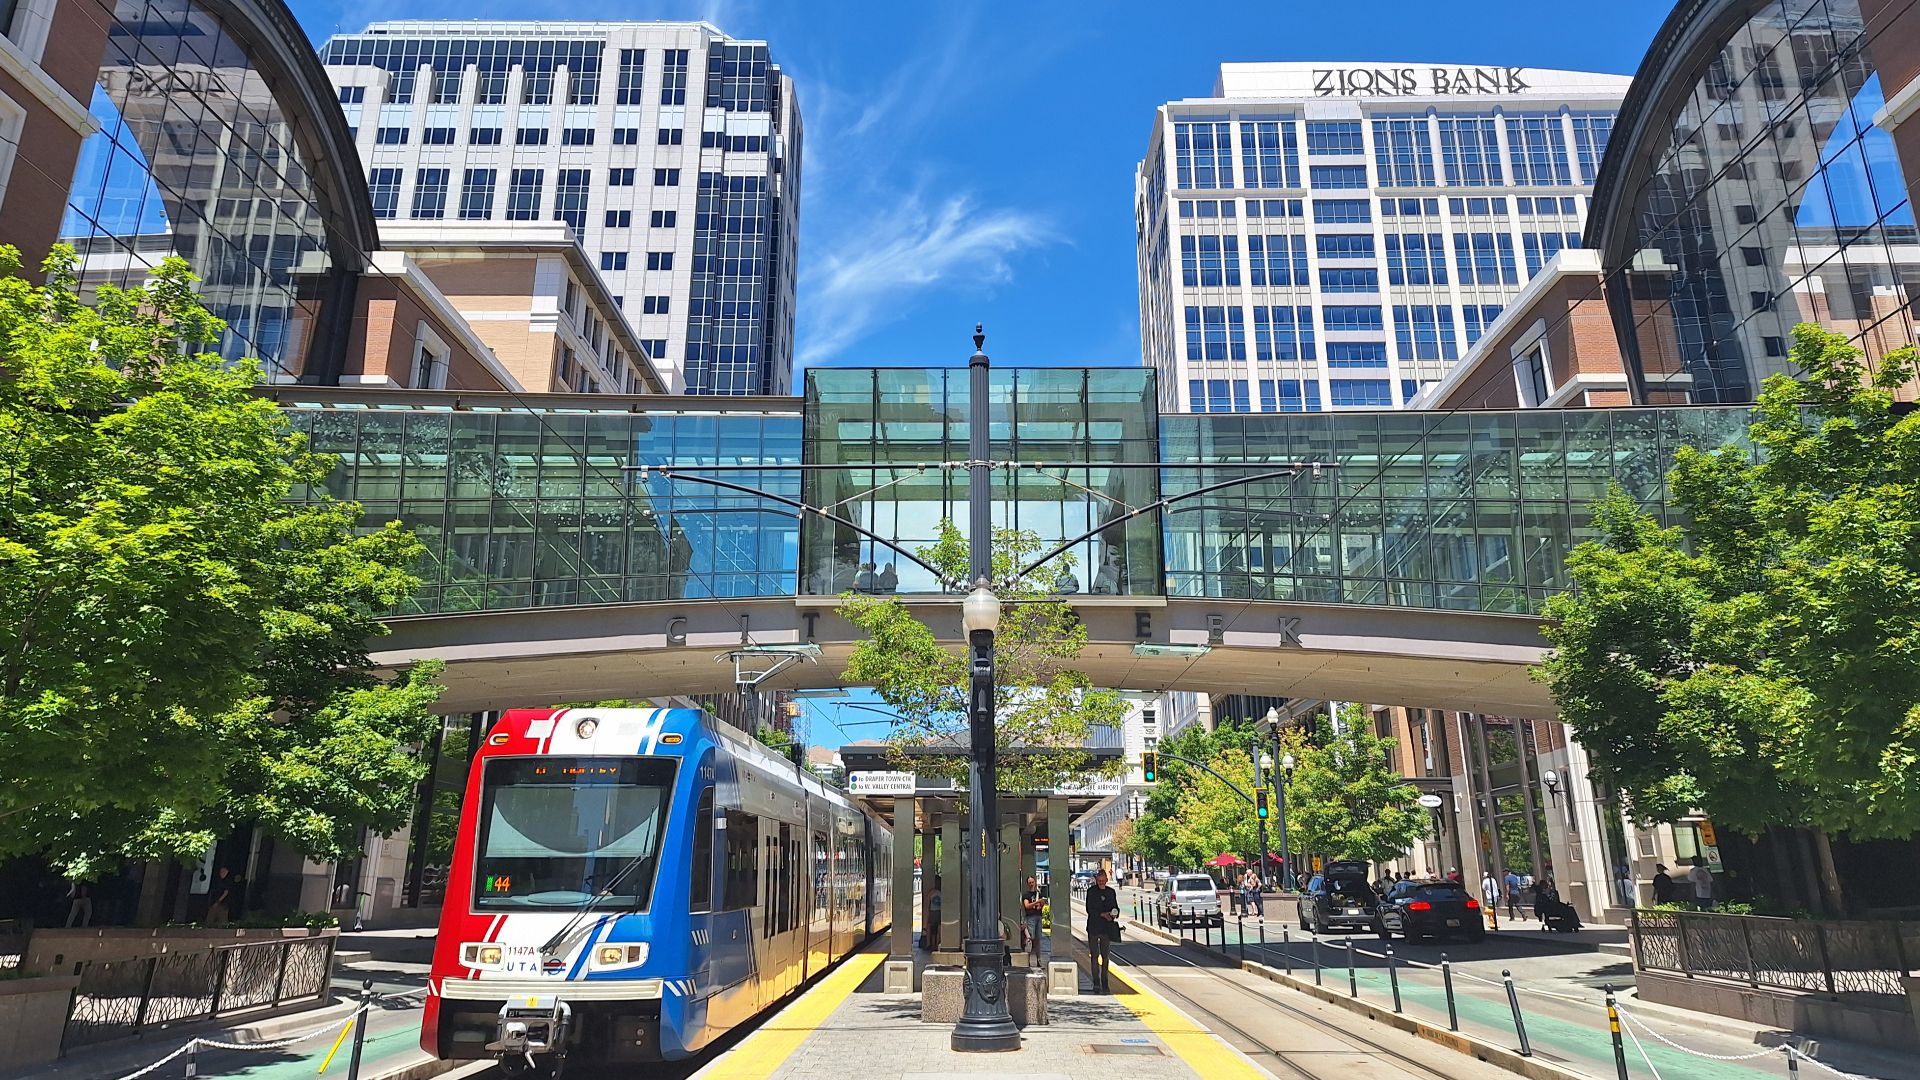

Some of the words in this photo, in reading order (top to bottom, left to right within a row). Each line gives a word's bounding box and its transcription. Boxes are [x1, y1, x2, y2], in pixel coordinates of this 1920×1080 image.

[1312, 68, 1417, 90] ZIONS
[1431, 67, 1531, 89] BANK
[494, 876, 511, 892] 44
[508, 946, 535, 956] 1147A
[506, 961, 538, 972] UTA
